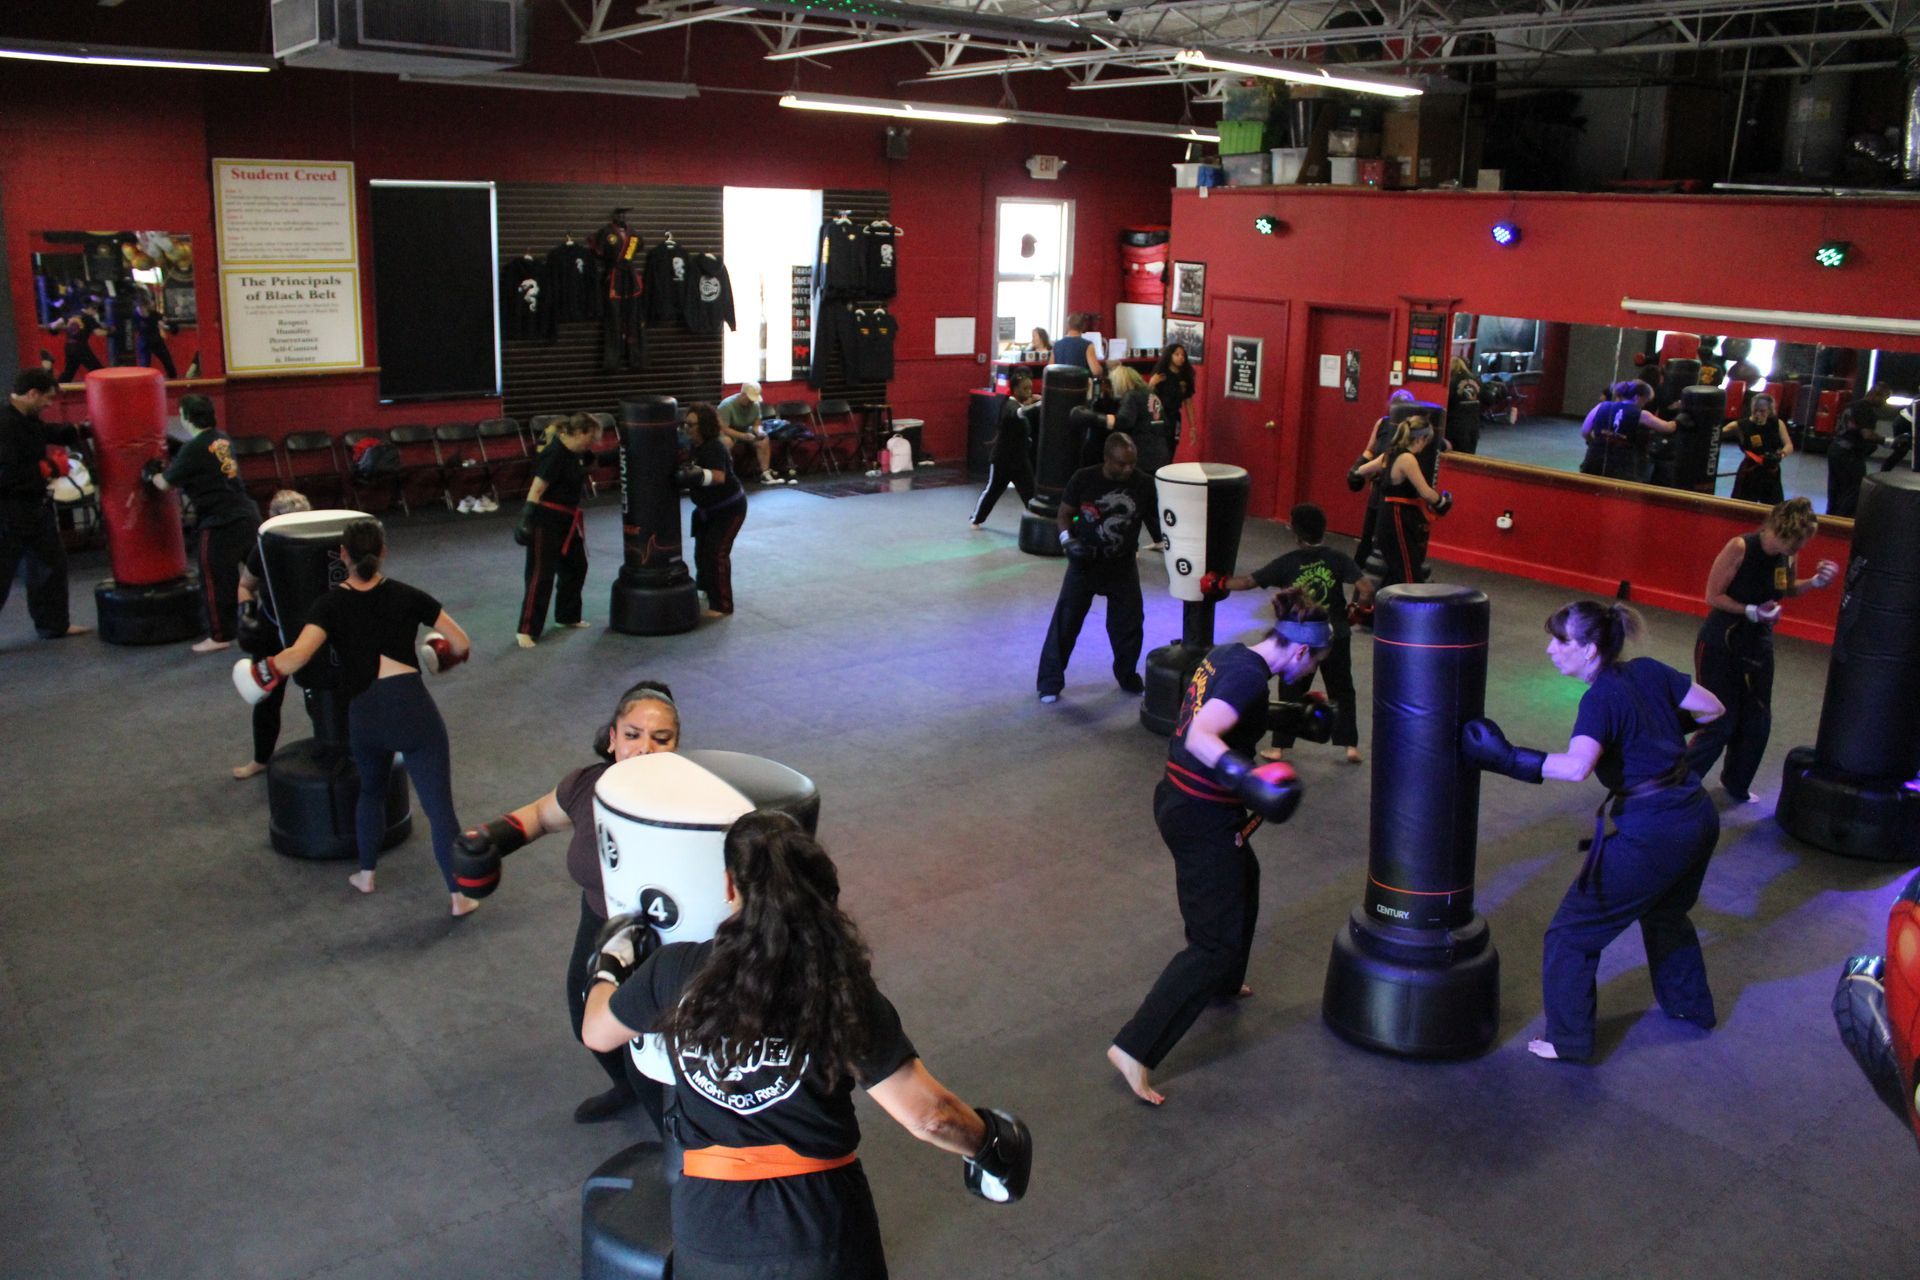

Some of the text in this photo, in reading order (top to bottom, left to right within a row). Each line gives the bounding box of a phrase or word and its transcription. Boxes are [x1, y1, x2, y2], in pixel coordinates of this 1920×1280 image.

[1040, 157, 1054, 172] EXIT
[231, 167, 337, 181] Student Creed
[240, 276, 342, 288] The Principals
[246, 289, 336, 301] of Black Belt
[647, 896, 669, 922] 4
[1376, 903, 1410, 920] CENTURY
[728, 1093, 756, 1108] FOR
[754, 1075, 788, 1102] RIGHT
